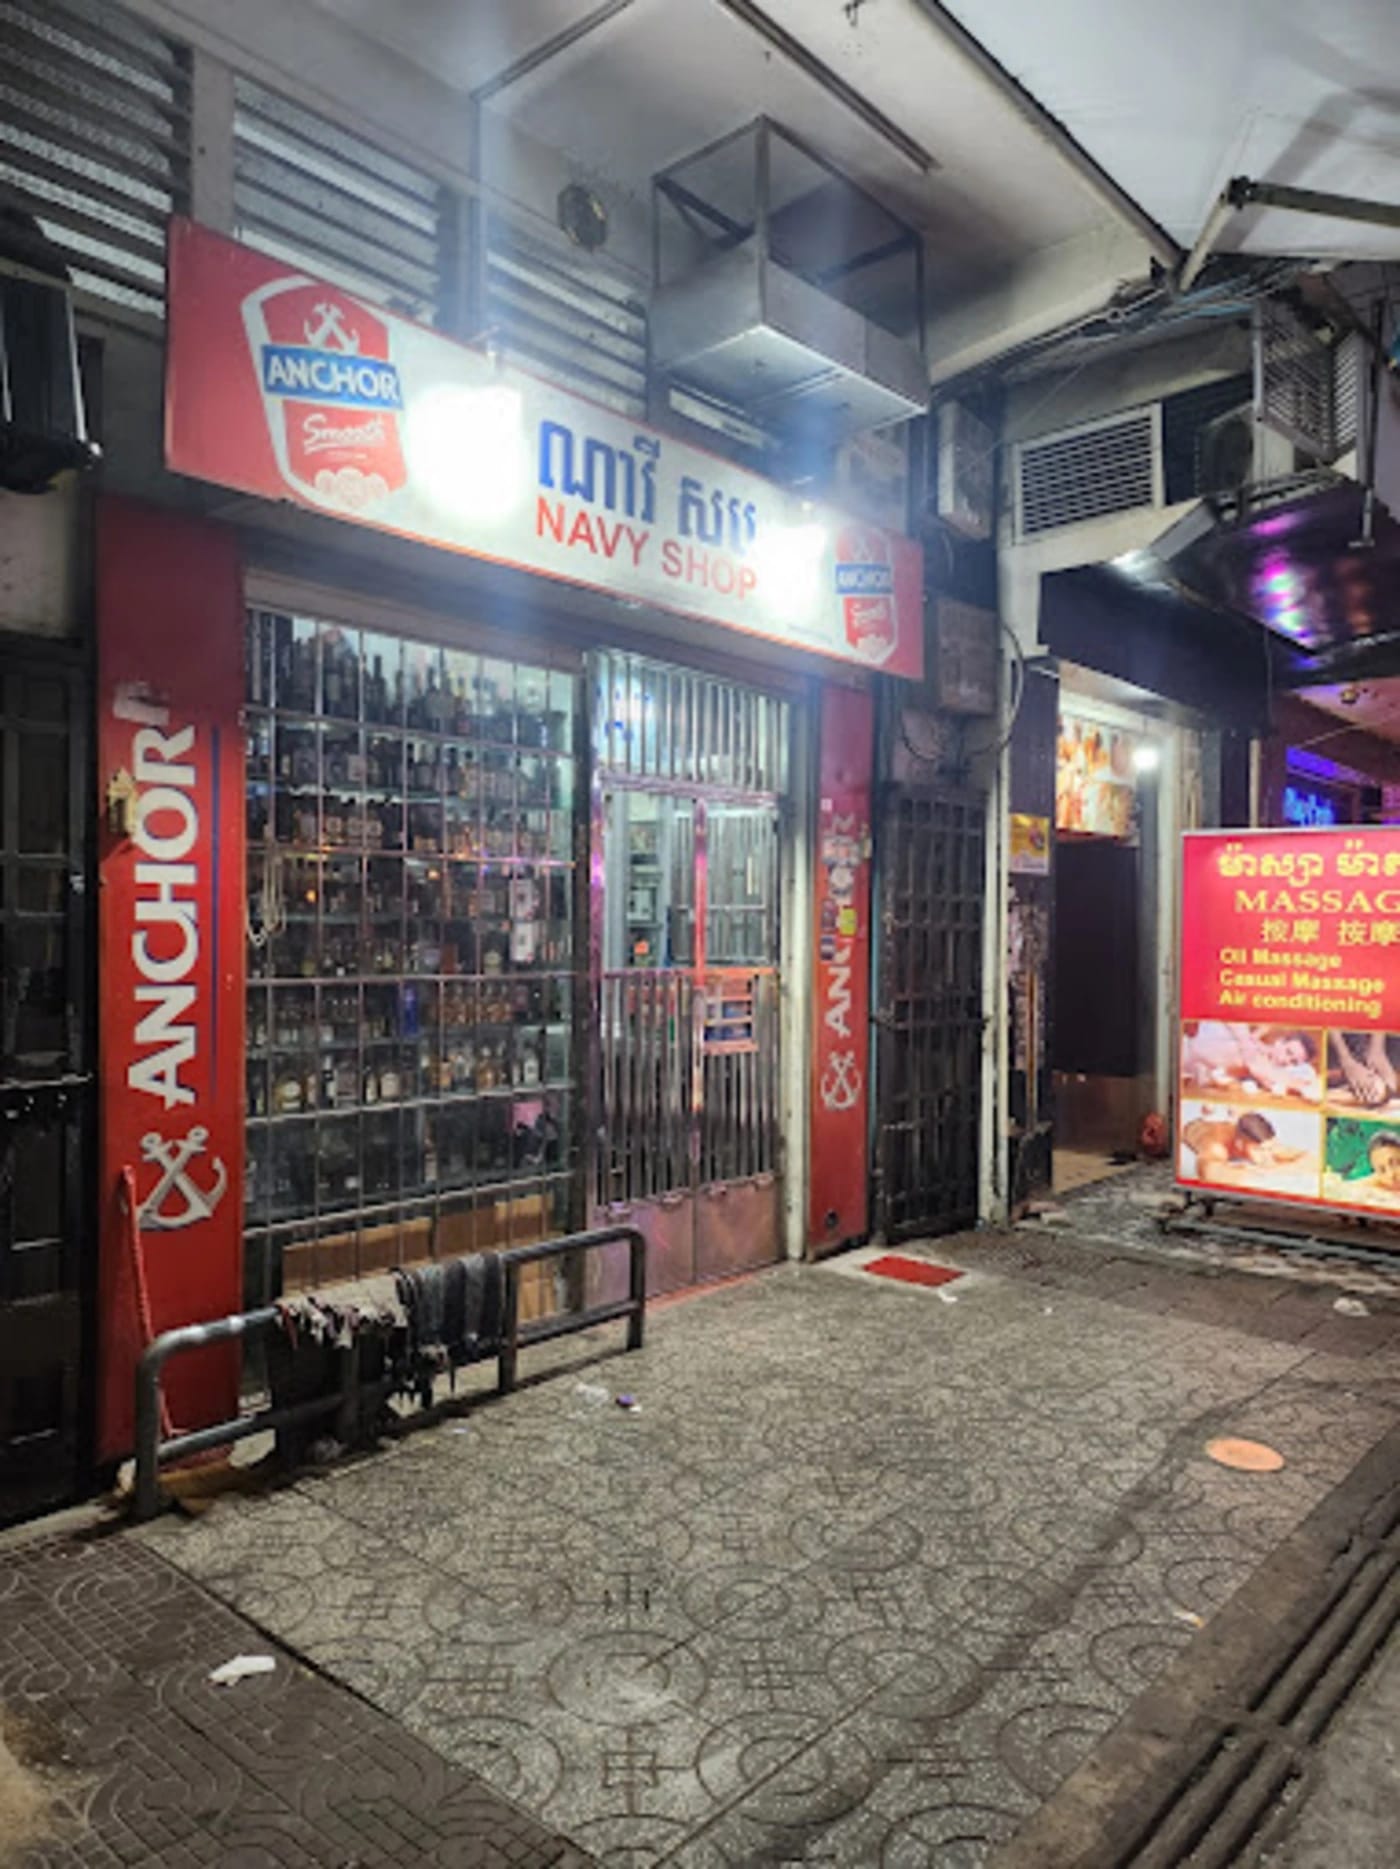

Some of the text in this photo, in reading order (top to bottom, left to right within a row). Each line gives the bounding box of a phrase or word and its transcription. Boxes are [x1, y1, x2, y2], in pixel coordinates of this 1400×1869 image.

[267, 354, 399, 400] ANCHOR
[535, 496, 758, 601] NAVY SHOP
[128, 725, 200, 1111] ANCHOR
[1219, 948, 1343, 971] Oil Massage
[1219, 969, 1384, 995] Casual Massage
[1219, 989, 1382, 1019] Air conditioning
